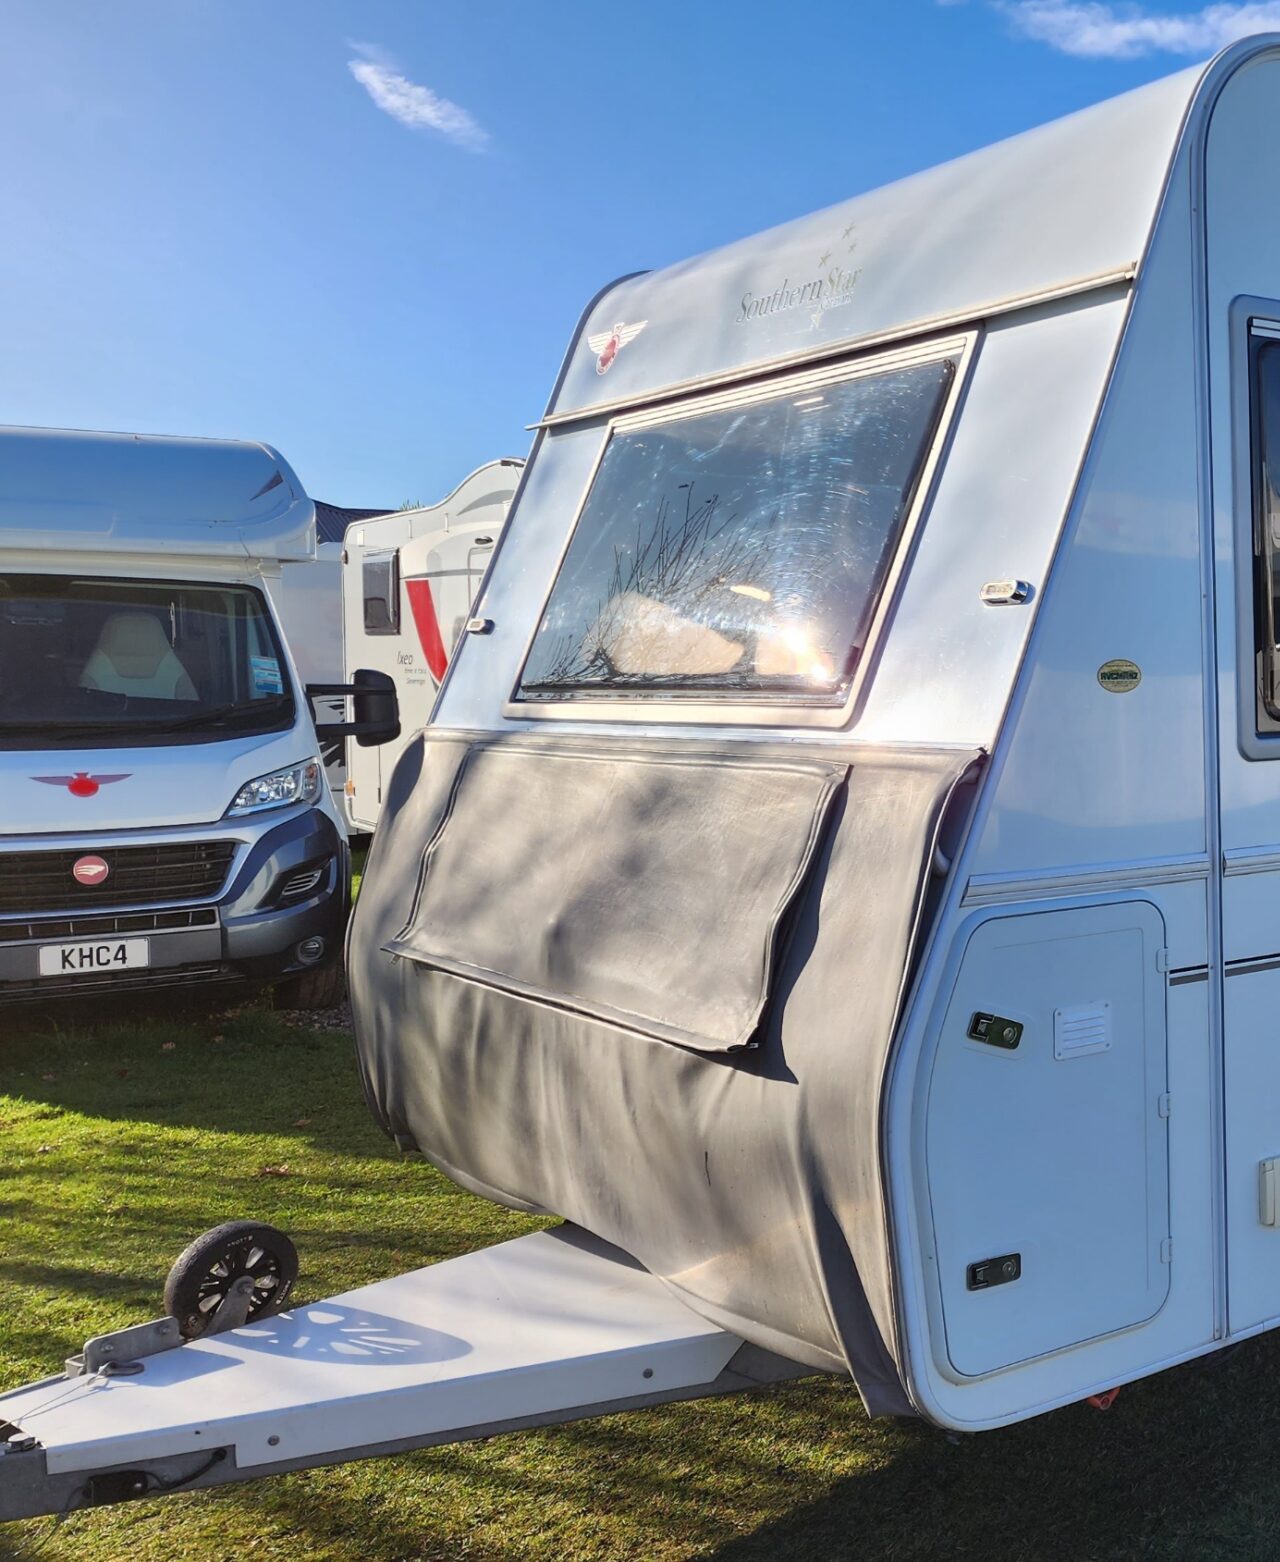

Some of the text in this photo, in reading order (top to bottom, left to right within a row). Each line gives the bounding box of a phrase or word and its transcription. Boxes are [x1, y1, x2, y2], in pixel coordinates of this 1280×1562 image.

[736, 266, 863, 322] Southern Star
[61, 944, 127, 970] KHC4
